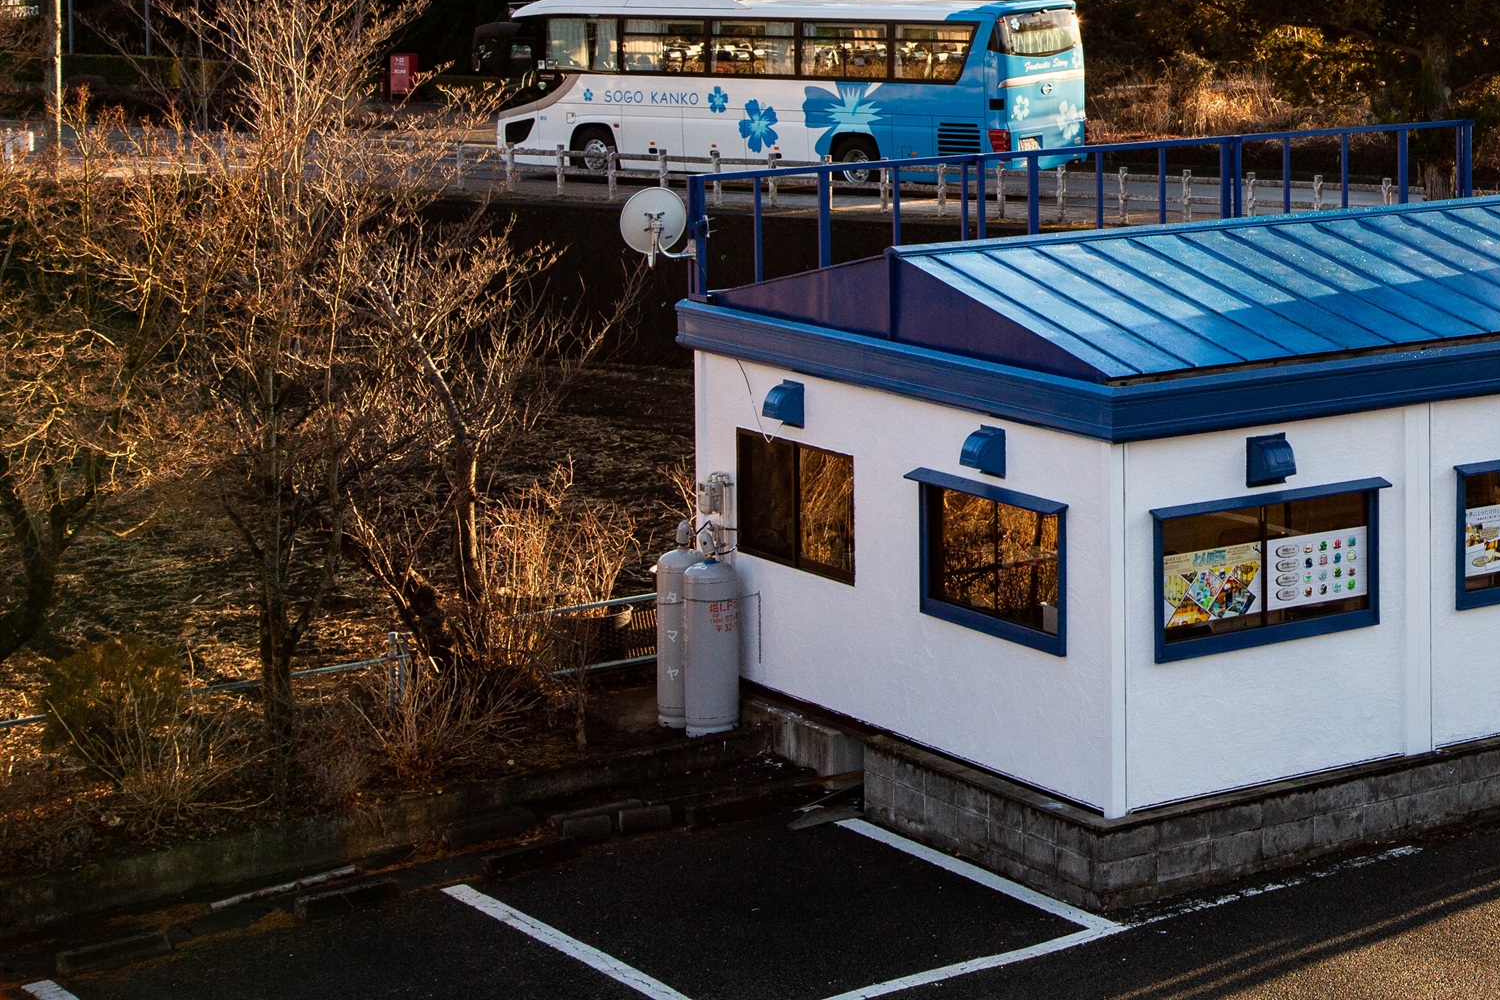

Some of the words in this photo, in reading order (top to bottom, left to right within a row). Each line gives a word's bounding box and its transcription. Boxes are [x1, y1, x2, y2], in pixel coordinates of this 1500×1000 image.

[1052, 58, 1068, 68] Story
[604, 90, 643, 104] SOGO
[650, 91, 699, 105] KANKO
[667, 590, 679, 681] タマヤ
